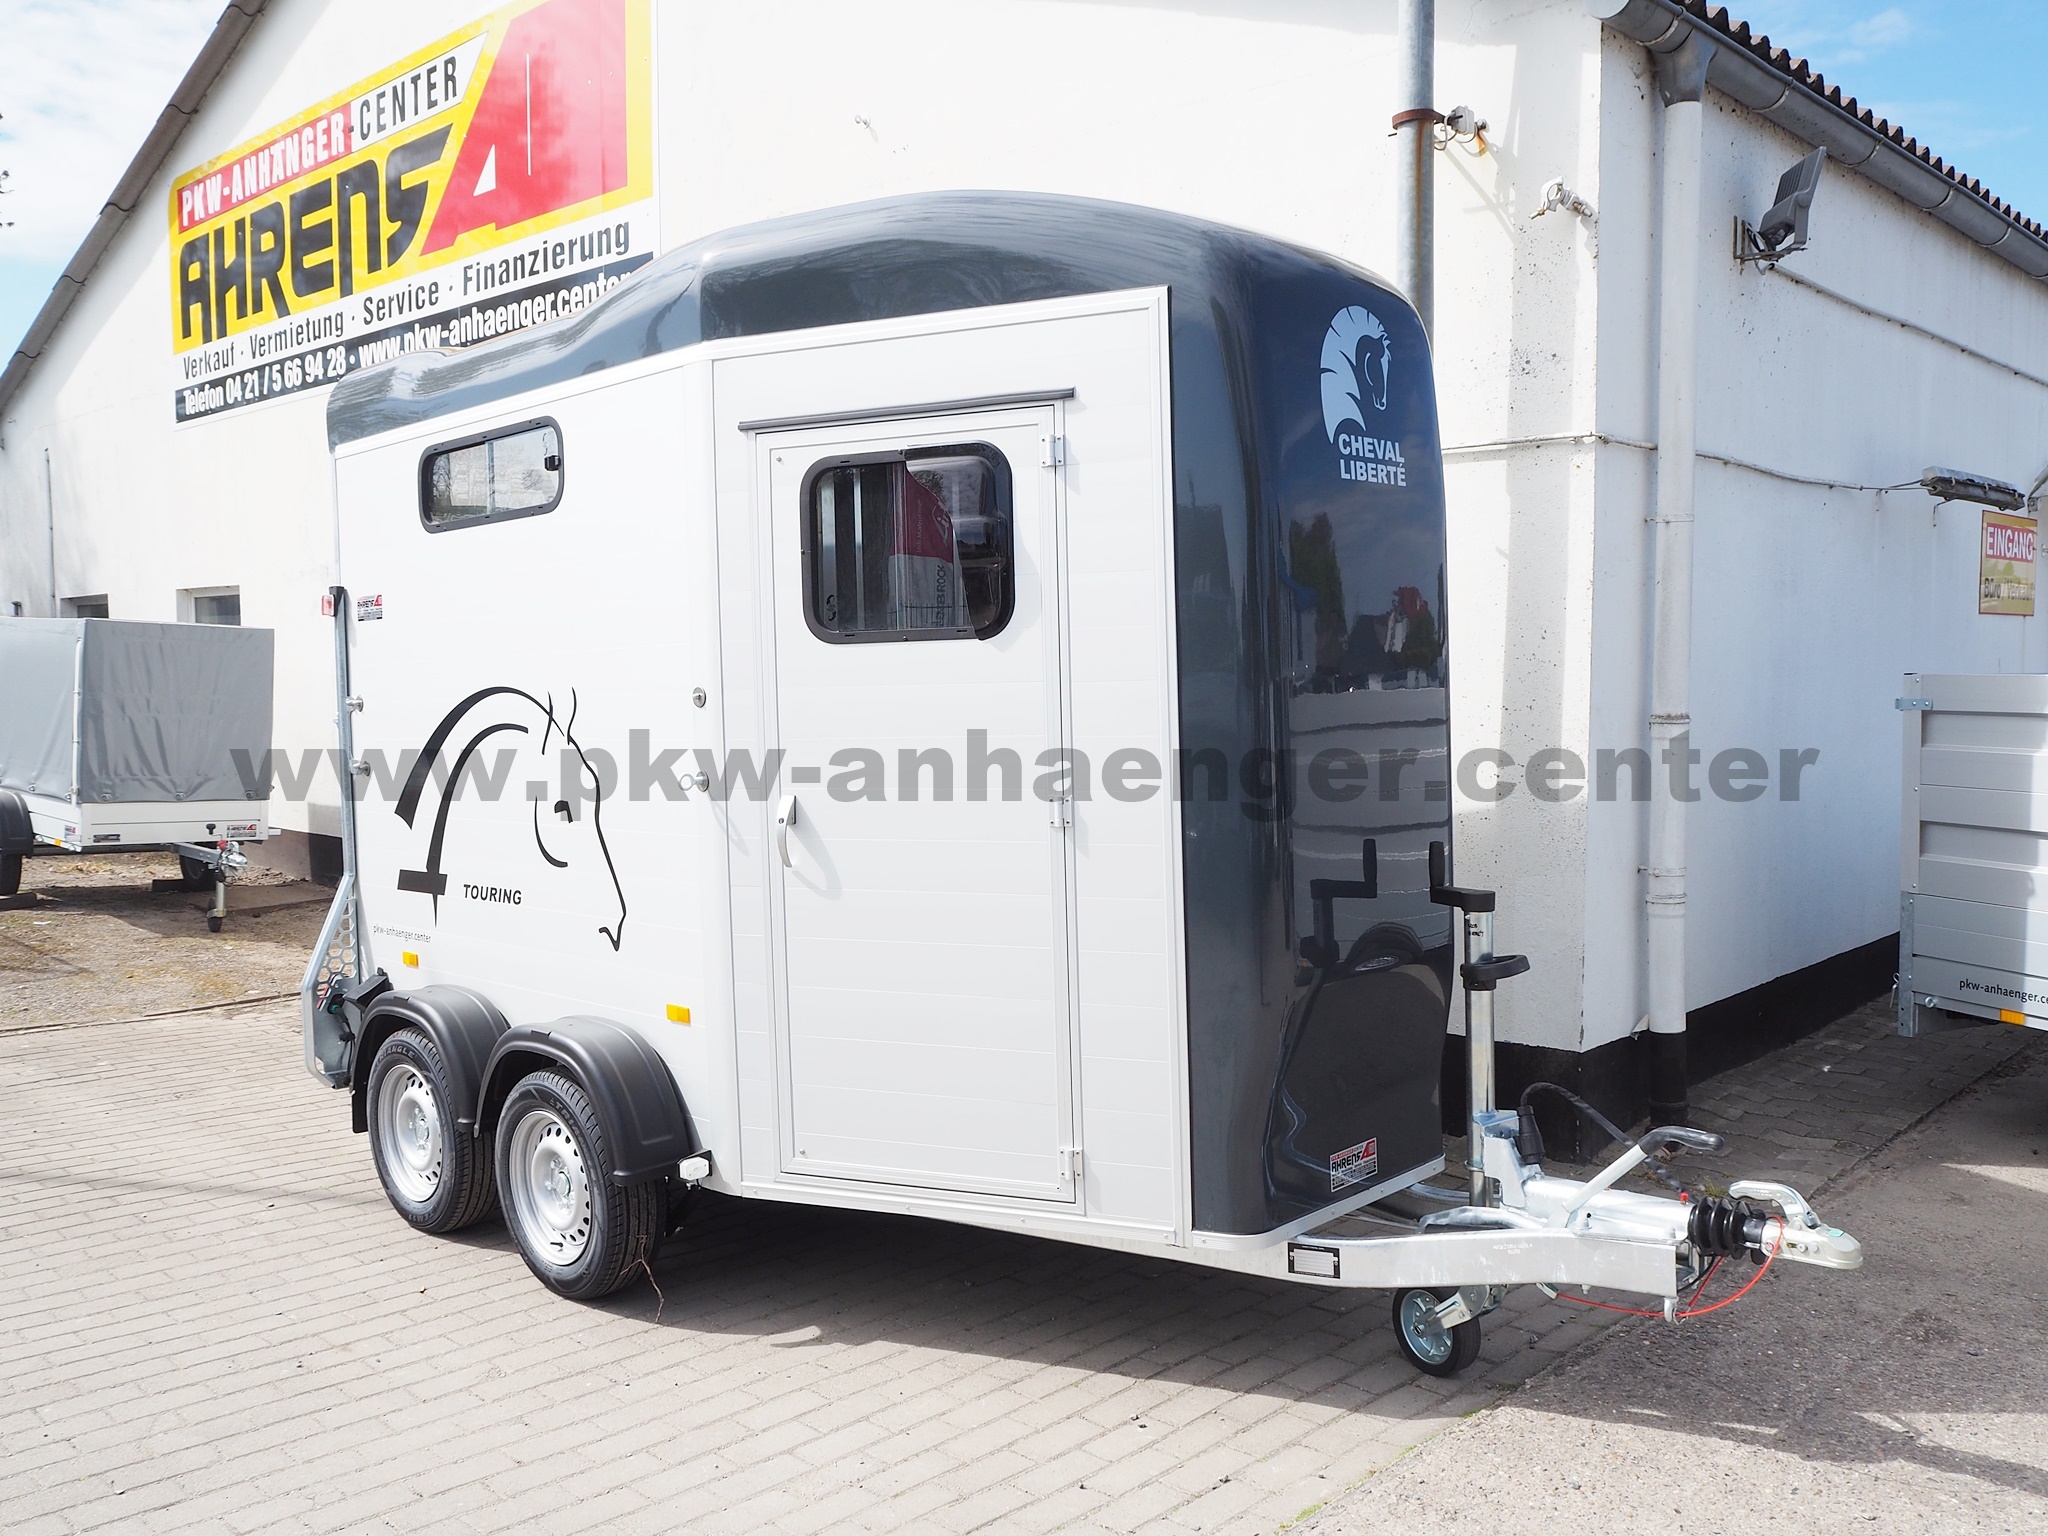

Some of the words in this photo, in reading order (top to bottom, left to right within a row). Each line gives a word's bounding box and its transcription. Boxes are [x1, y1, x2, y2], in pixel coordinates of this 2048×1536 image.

[180, 122, 454, 344] AHRENS
[183, 342, 236, 380] Verkauf
[249, 311, 344, 360] Vermietung
[363, 281, 440, 326] Service
[463, 221, 630, 297] Finanzierung
[183, 383, 224, 416] Telefon
[226, 375, 243, 405] 04
[243, 371, 260, 400] 21
[272, 363, 282, 392] 5
[283, 359, 302, 389] 66
[304, 354, 324, 384] 94
[326, 345, 347, 378] 28
[1338, 433, 1405, 463] CHEVAL
[1340, 459, 1407, 487] LIBERTÉ
[1986, 526, 2034, 561] EINGANG
[1984, 577, 2001, 599] Büro
[463, 884, 522, 905] TOURING
[373, 924, 431, 943] pkw-anhaenger.center
[1331, 1150, 1363, 1173] AHRENS
